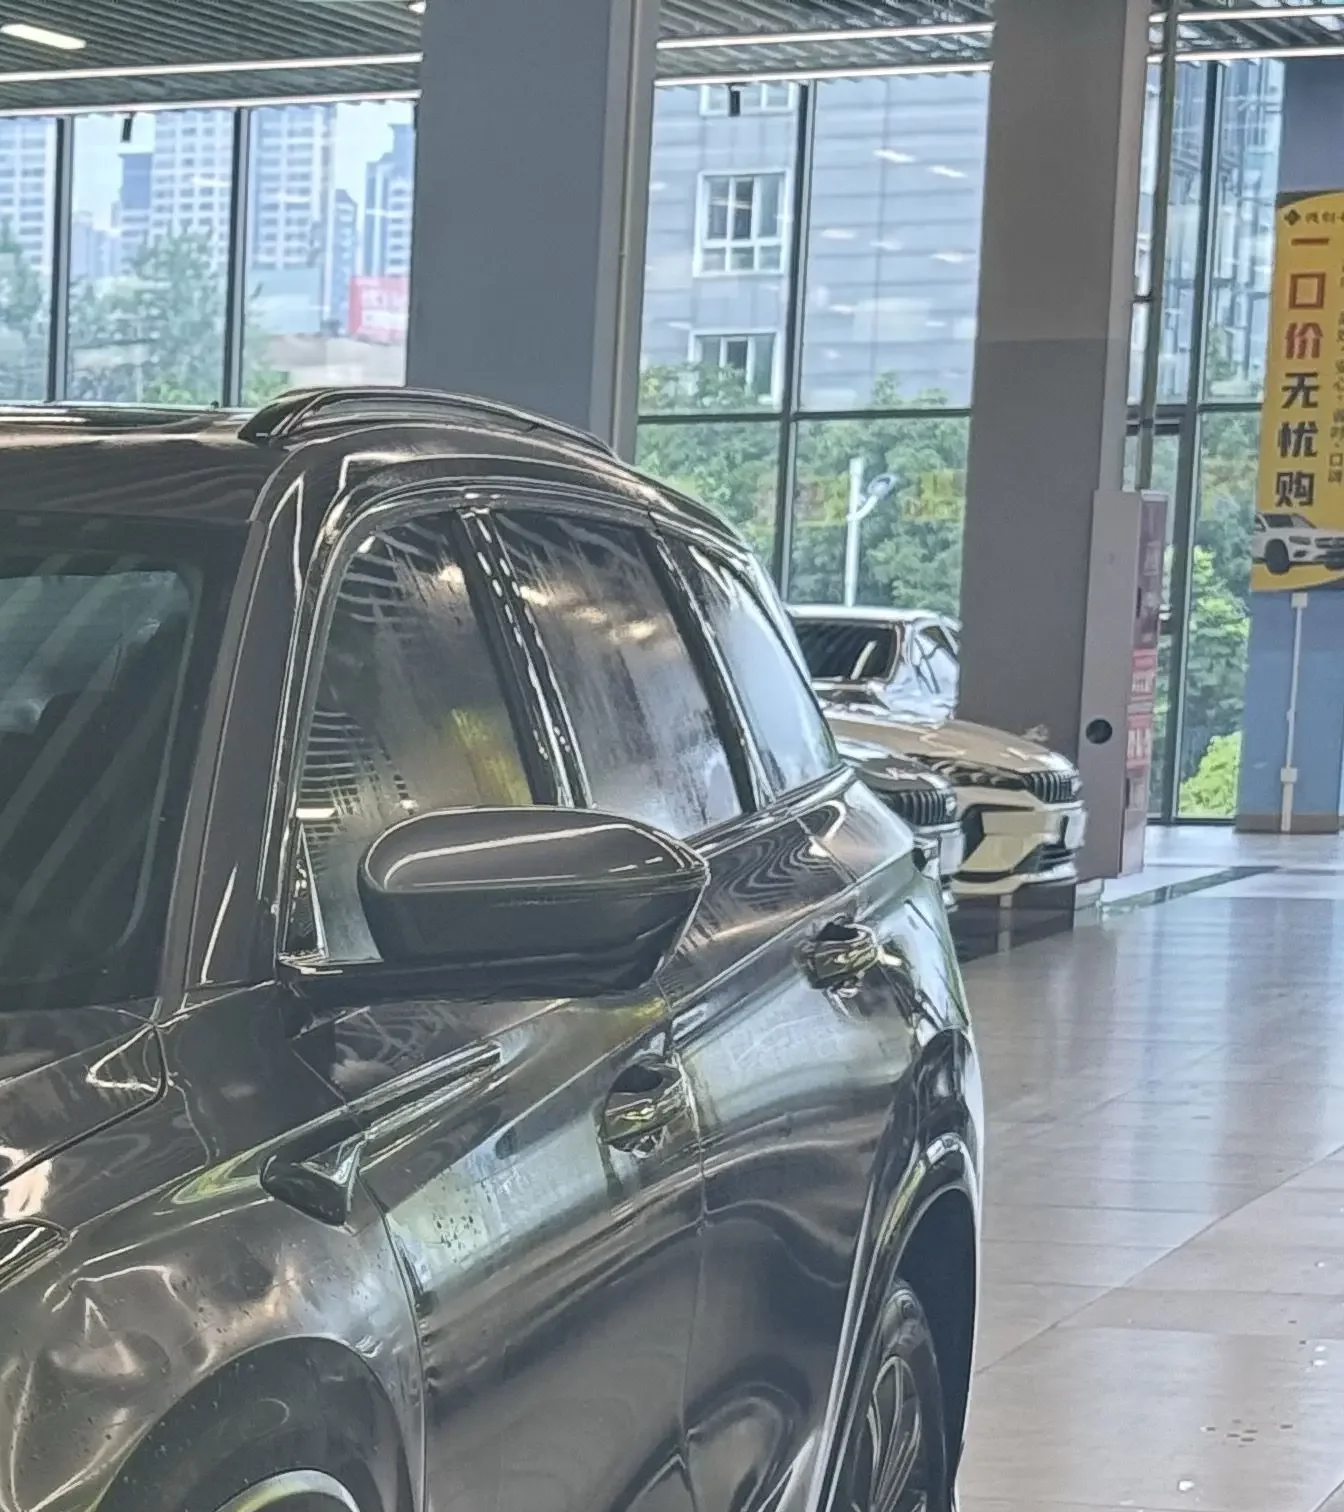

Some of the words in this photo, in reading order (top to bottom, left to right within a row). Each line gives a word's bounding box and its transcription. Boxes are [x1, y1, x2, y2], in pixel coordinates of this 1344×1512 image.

[1276, 237, 1329, 507] 一口价无忧购
